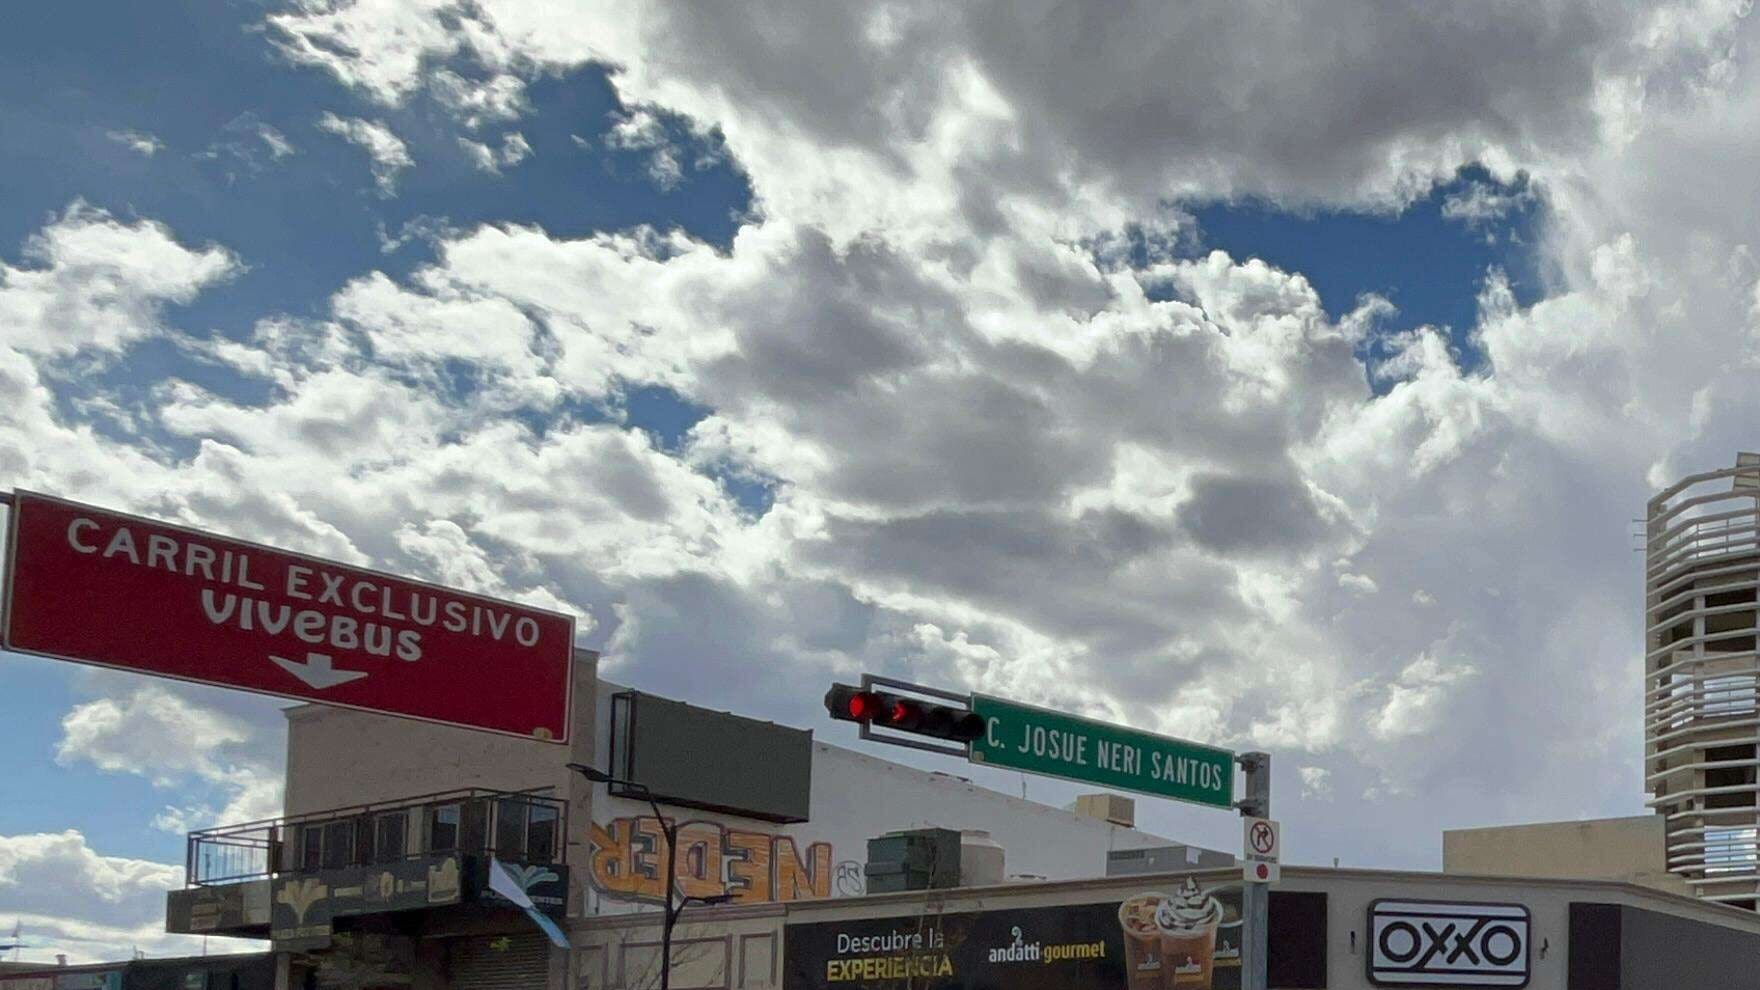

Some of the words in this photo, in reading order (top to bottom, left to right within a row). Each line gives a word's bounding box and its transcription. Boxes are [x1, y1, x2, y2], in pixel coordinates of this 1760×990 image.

[66, 517, 264, 592] CARRIL
[286, 564, 540, 648] EXCLUSIVO
[987, 716, 1005, 749] C.
[1018, 724, 1087, 765] JOSUE
[1098, 740, 1142, 776] NERI
[1151, 751, 1222, 791] SANTOS
[837, 929, 923, 954] Descubre
[929, 928, 944, 949] la
[1378, 918, 1522, 969] OXXO
[827, 955, 954, 982] EXPERIENCIA
